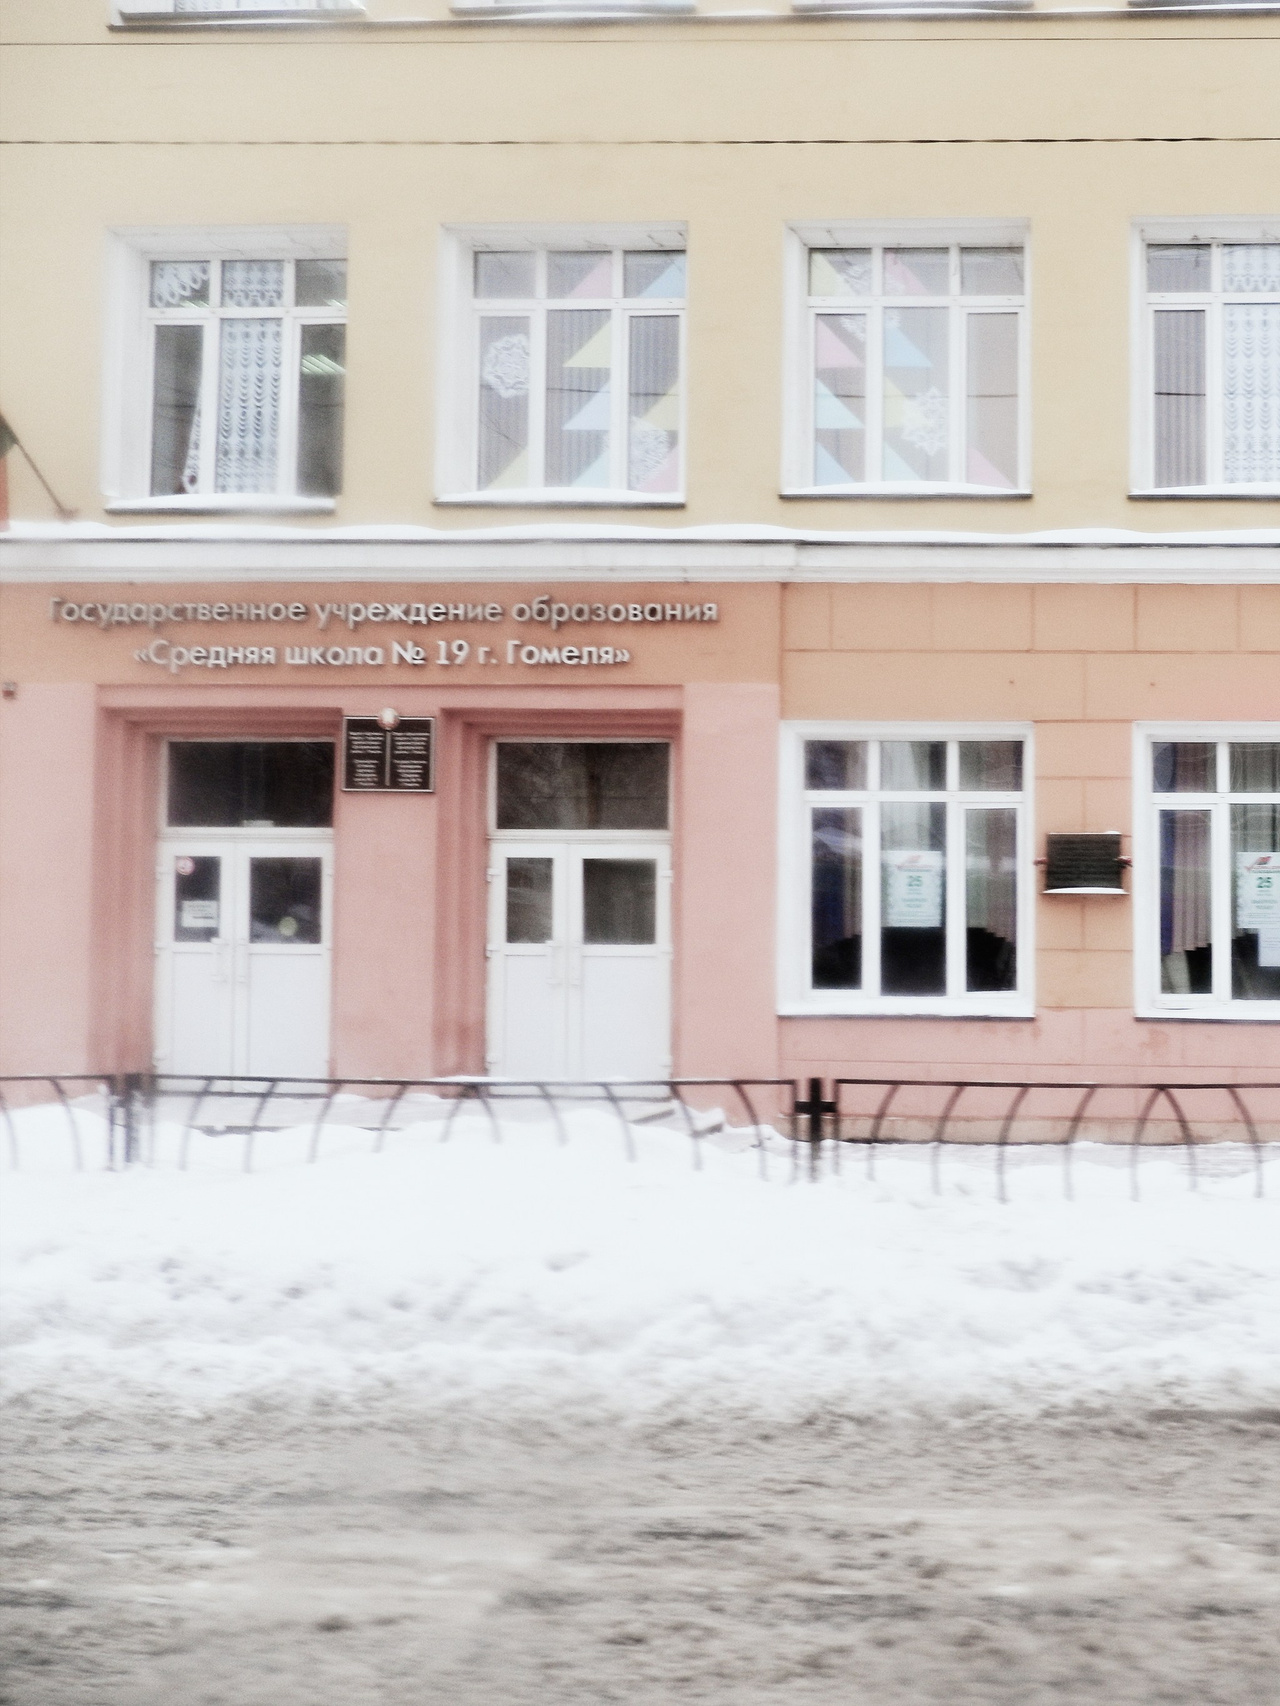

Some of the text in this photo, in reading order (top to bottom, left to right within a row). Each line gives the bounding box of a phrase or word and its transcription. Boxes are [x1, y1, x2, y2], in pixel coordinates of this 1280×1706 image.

[50, 595, 718, 631] Государственное учреждение образования
[133, 639, 631, 673] «Средняя школа № 19 г. Гомеля»
[1256, 876, 1273, 889] 25
